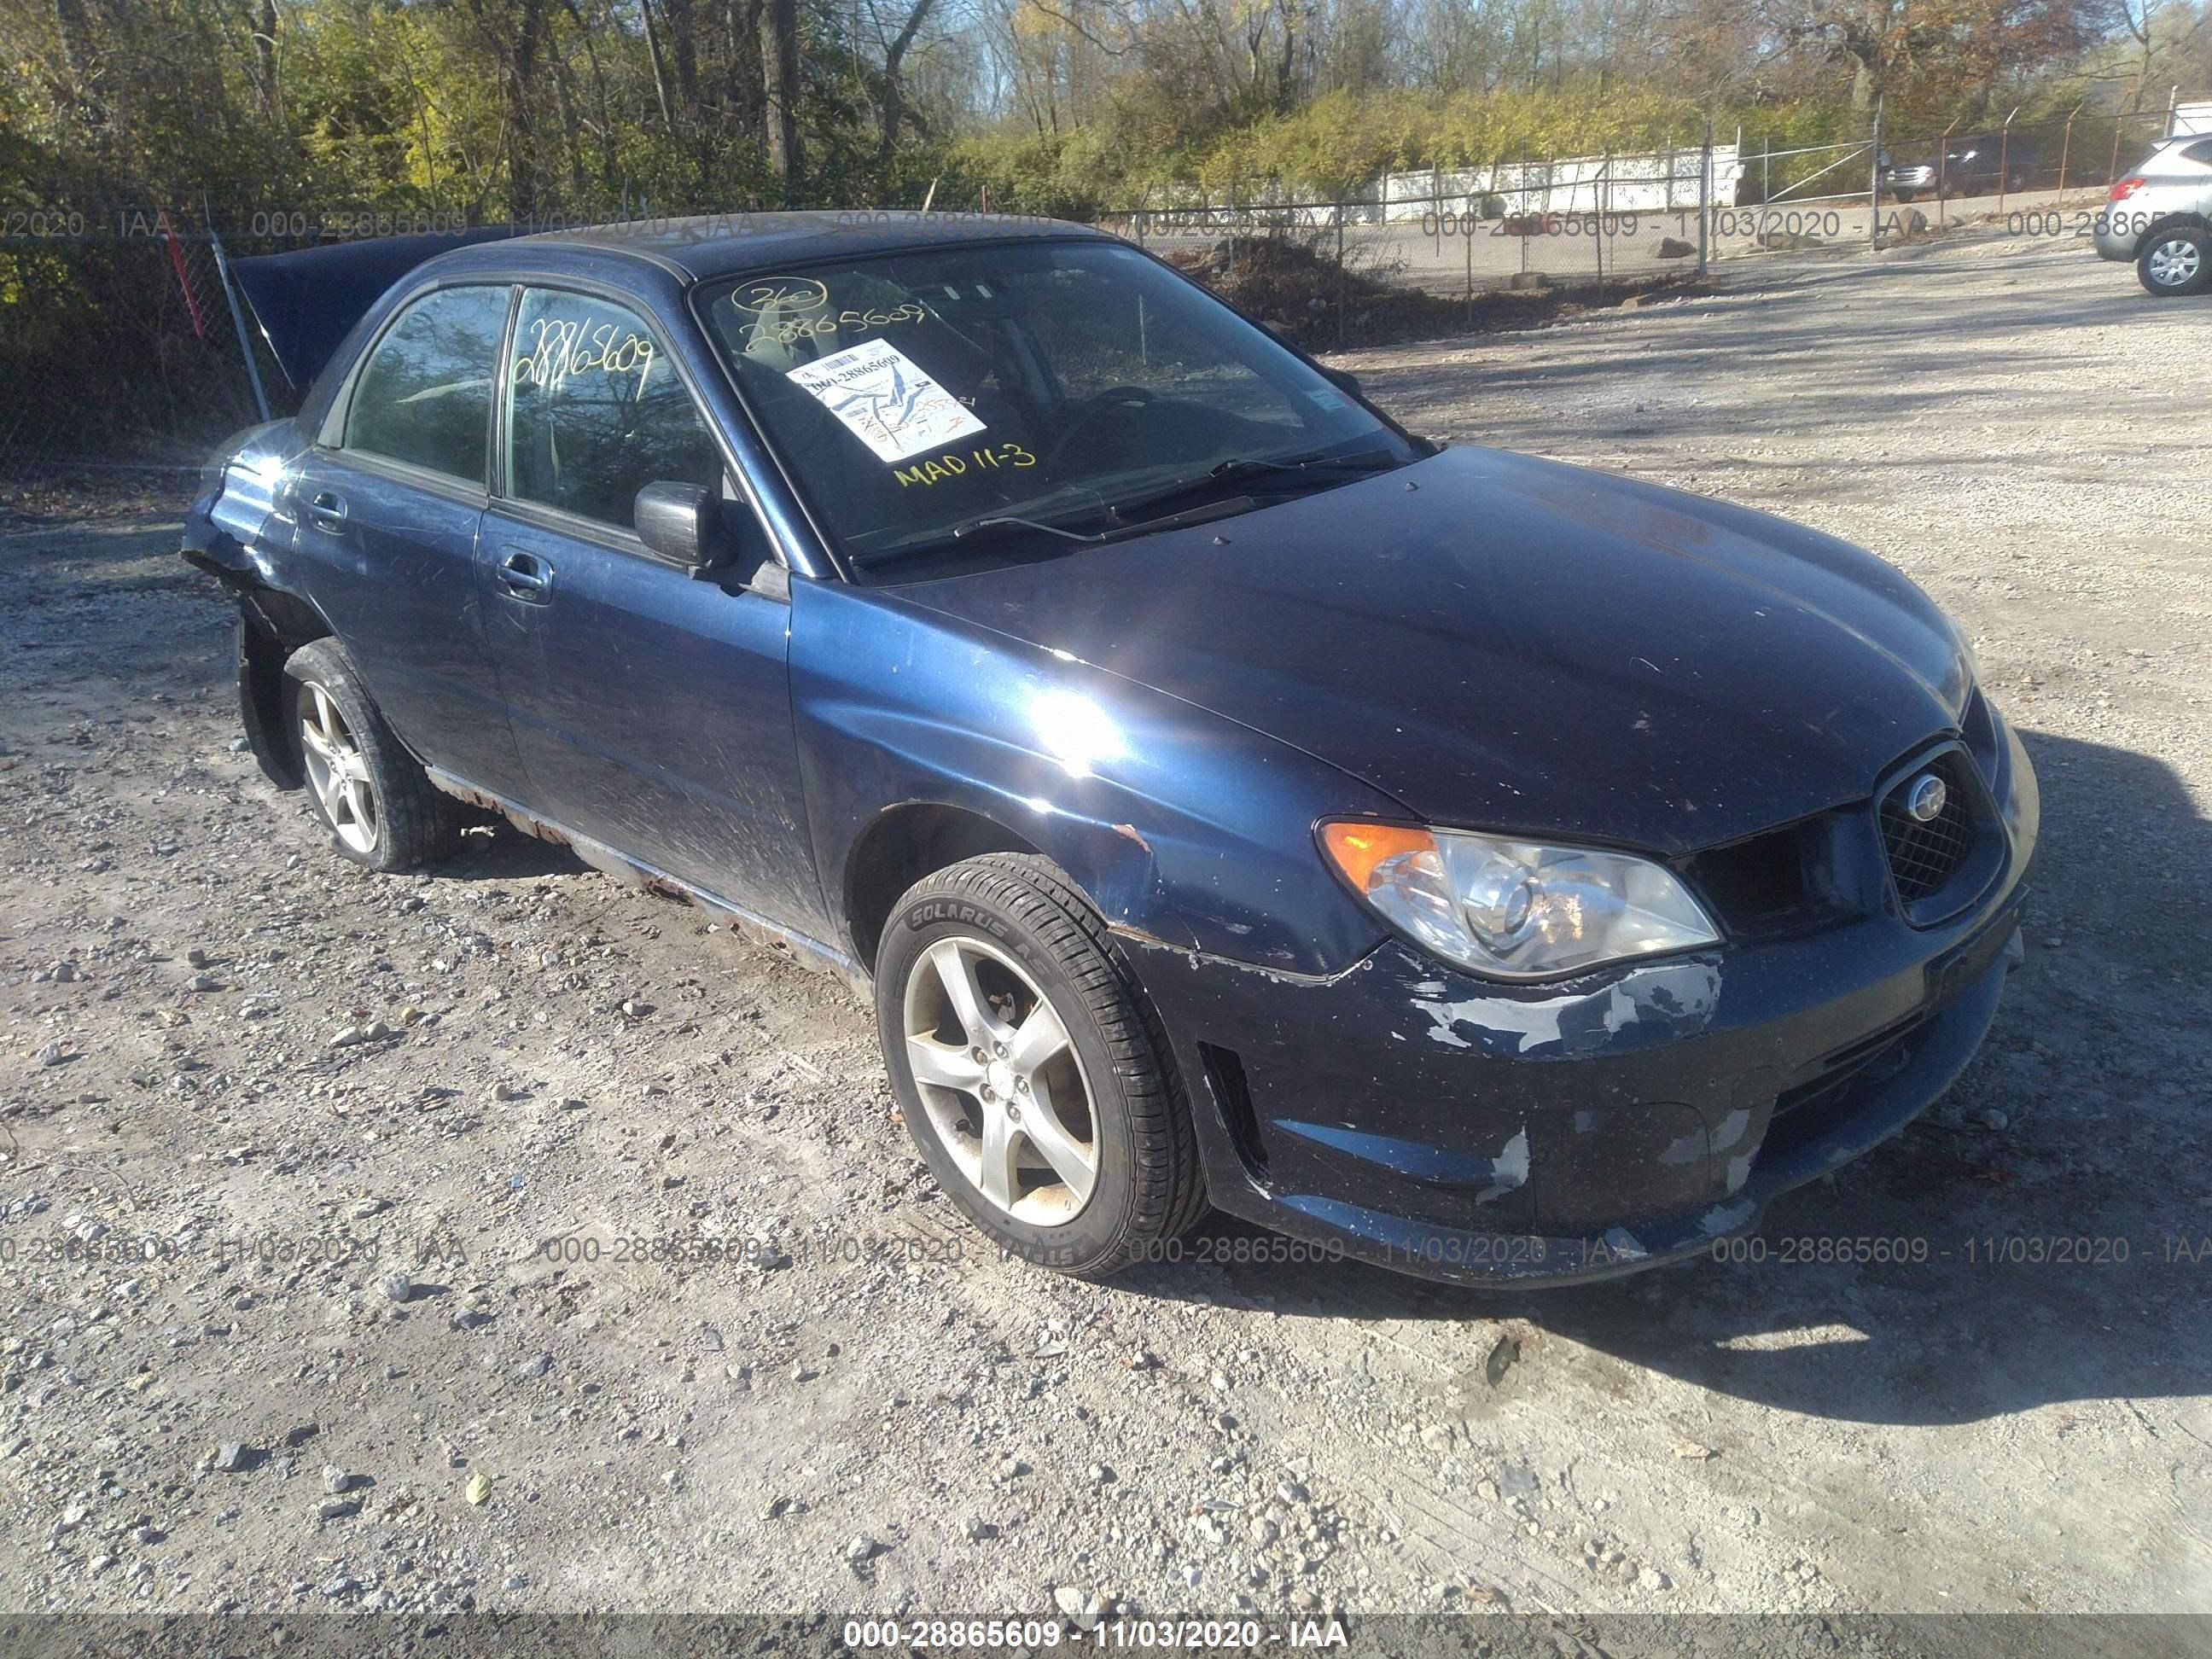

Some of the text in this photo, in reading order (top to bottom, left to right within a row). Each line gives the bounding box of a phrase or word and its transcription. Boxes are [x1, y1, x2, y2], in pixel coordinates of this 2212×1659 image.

[739, 305, 925, 352] 28865609
[514, 317, 654, 403] 28865609
[894, 444, 1036, 486] MAD 11-3
[912, 904, 1051, 975] SOLARUS AS
